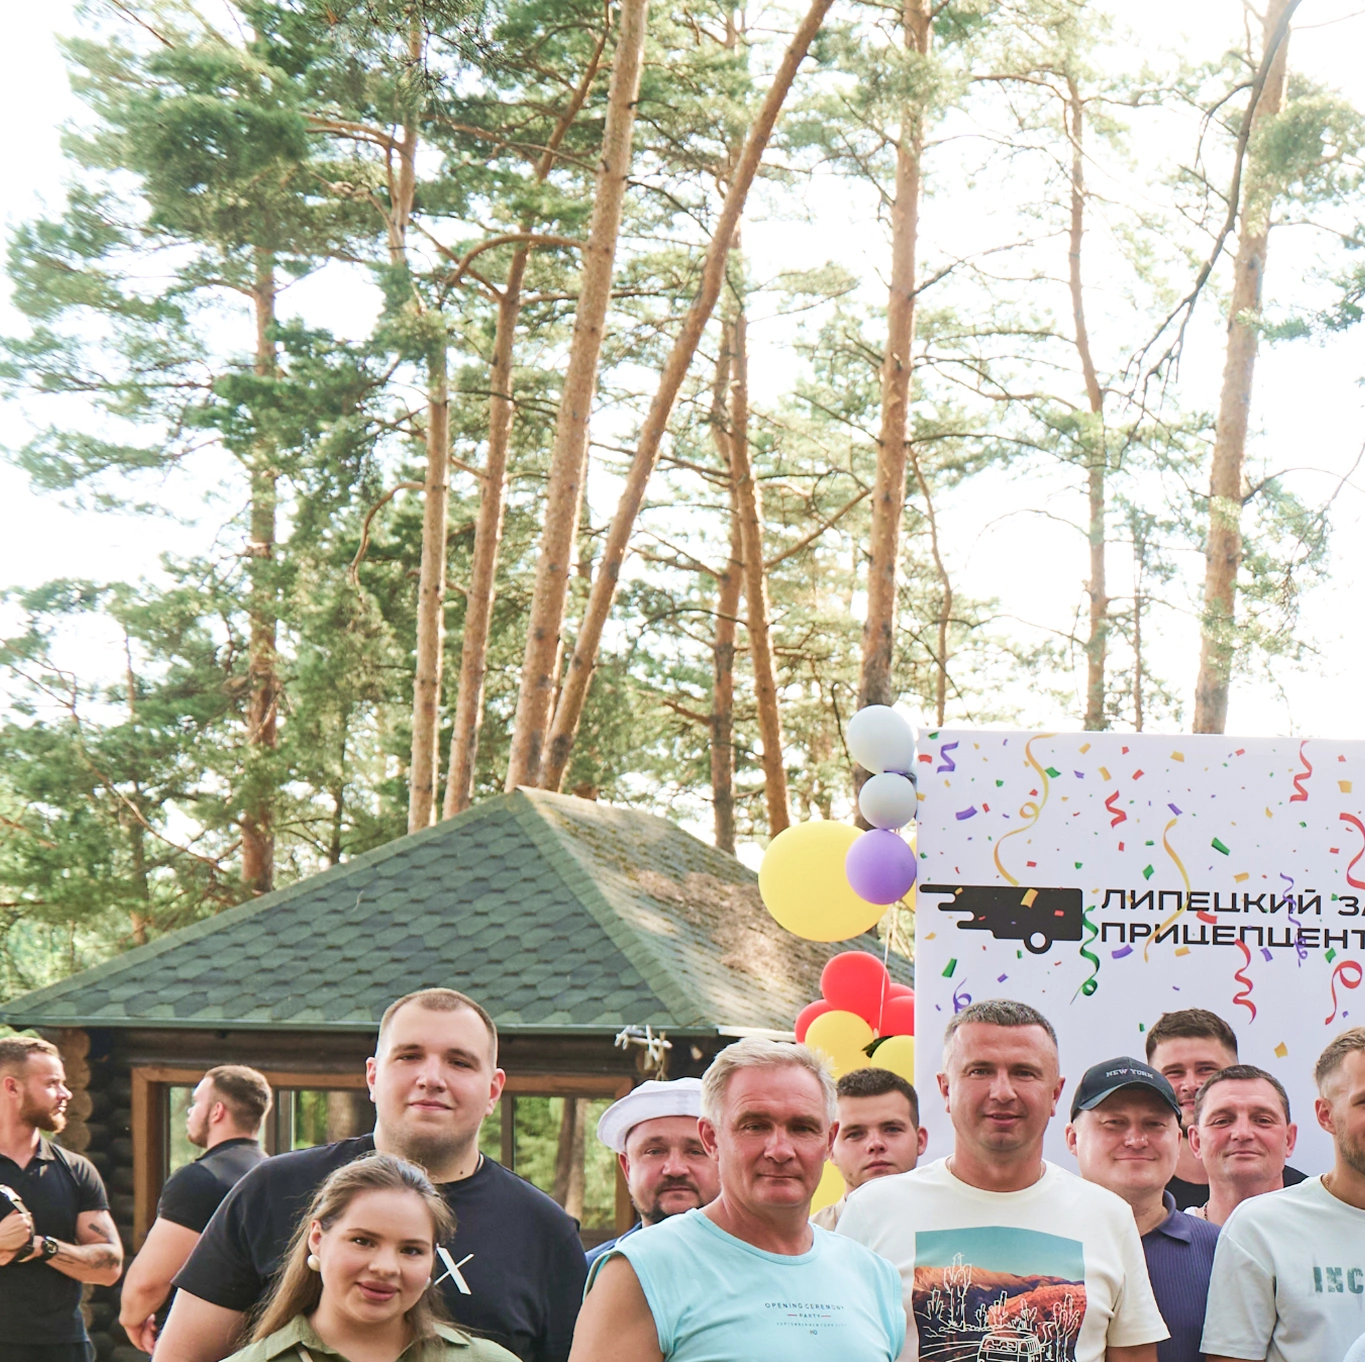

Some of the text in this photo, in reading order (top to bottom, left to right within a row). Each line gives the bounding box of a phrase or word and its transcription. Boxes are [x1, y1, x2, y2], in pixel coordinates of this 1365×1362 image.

[1102, 887, 1322, 915] ЛИПЕЦКИЙ
[1106, 1068, 1154, 1079] NEW YORK
